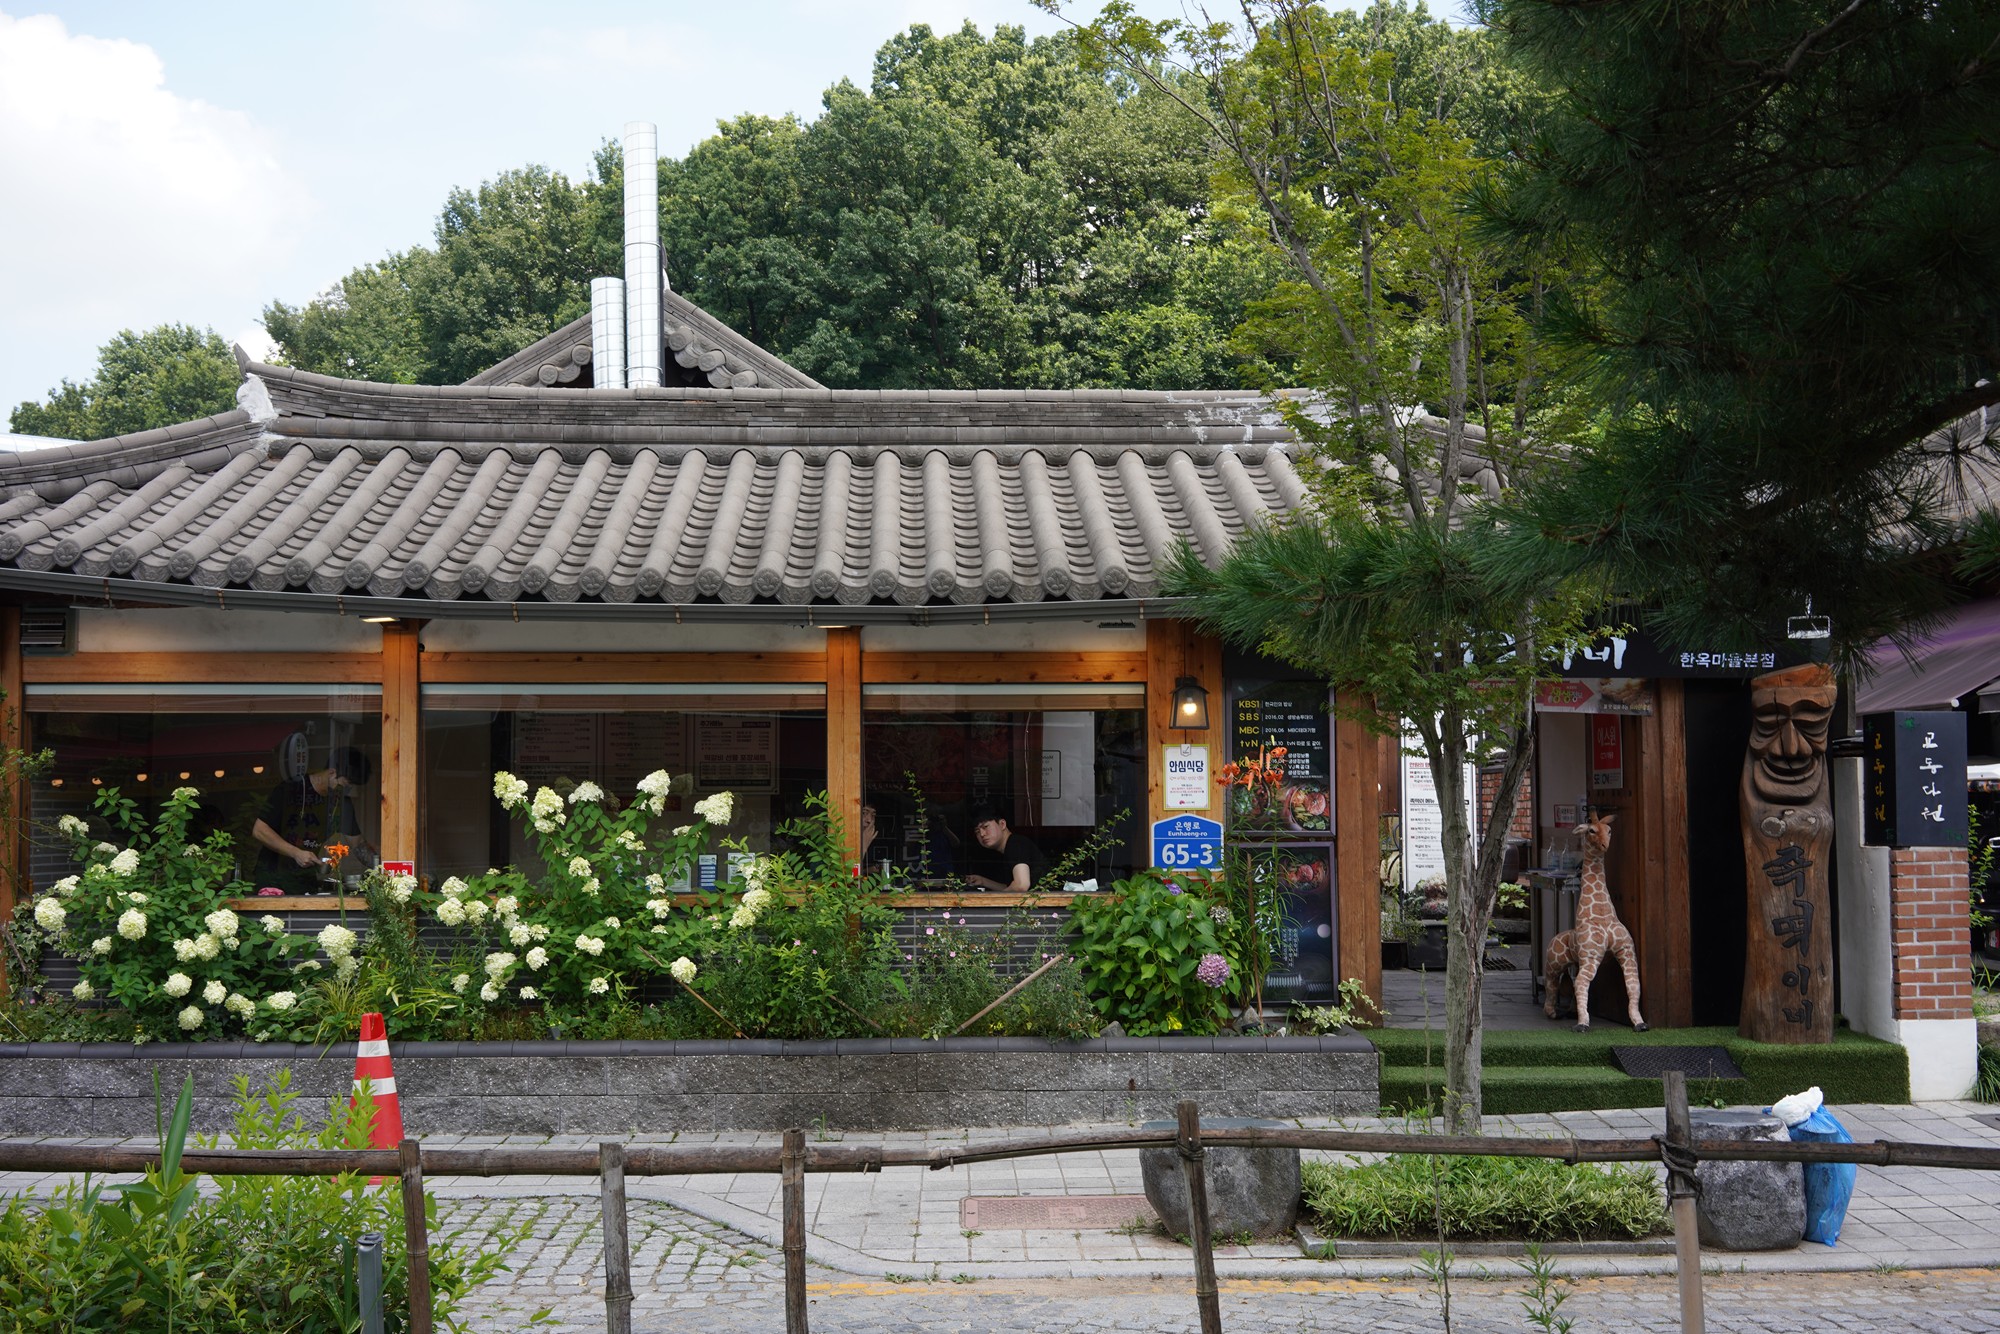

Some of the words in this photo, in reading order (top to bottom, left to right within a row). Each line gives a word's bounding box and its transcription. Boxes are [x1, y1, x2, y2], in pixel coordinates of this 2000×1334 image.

[1680, 652, 1775, 668] 한옥마을본점
[1238, 700, 1260, 708] KBS1
[1239, 713, 1260, 721] SBS
[1239, 726, 1260, 734] MBC
[1169, 760, 1204, 773] 안심식당
[1174, 821, 1201, 832] 은행로
[1167, 831, 1208, 839] Eunhaeng-ro
[1161, 843, 1213, 865] 65-3
